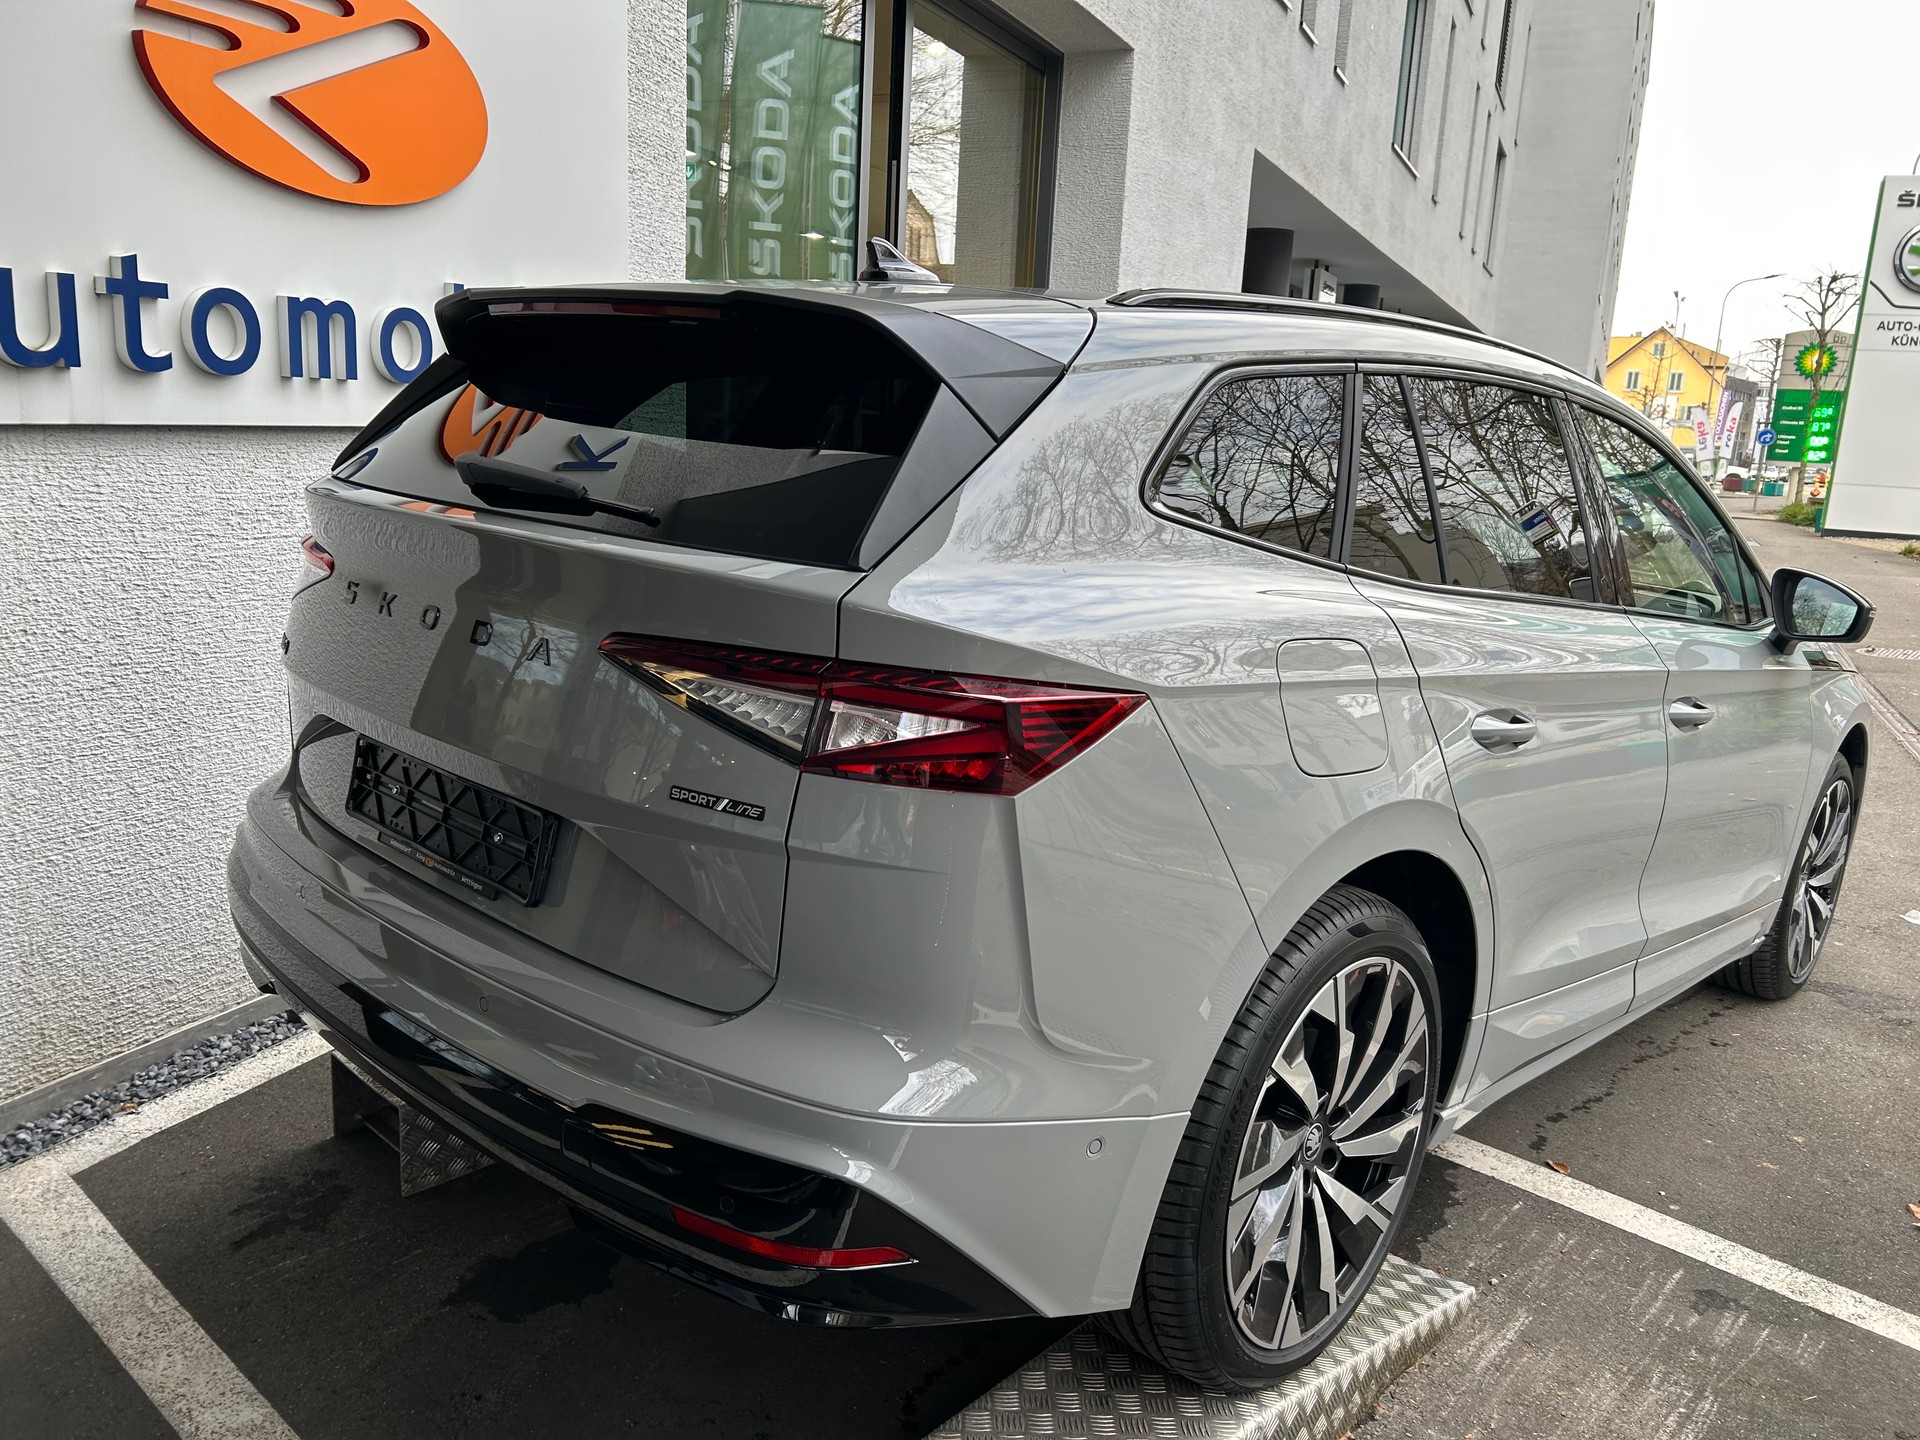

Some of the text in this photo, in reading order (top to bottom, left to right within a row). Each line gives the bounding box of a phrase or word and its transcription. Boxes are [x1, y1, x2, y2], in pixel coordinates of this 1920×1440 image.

[1897, 190, 1920, 208] Š
[1833, 334, 1847, 345] bp
[1876, 321, 1920, 331] AUTO-
[1715, 391, 1729, 434] OCCASIONEN
[1725, 417, 1737, 448] reka
[346, 580, 552, 667] SKODA
[671, 788, 763, 818] SPORT LINE
